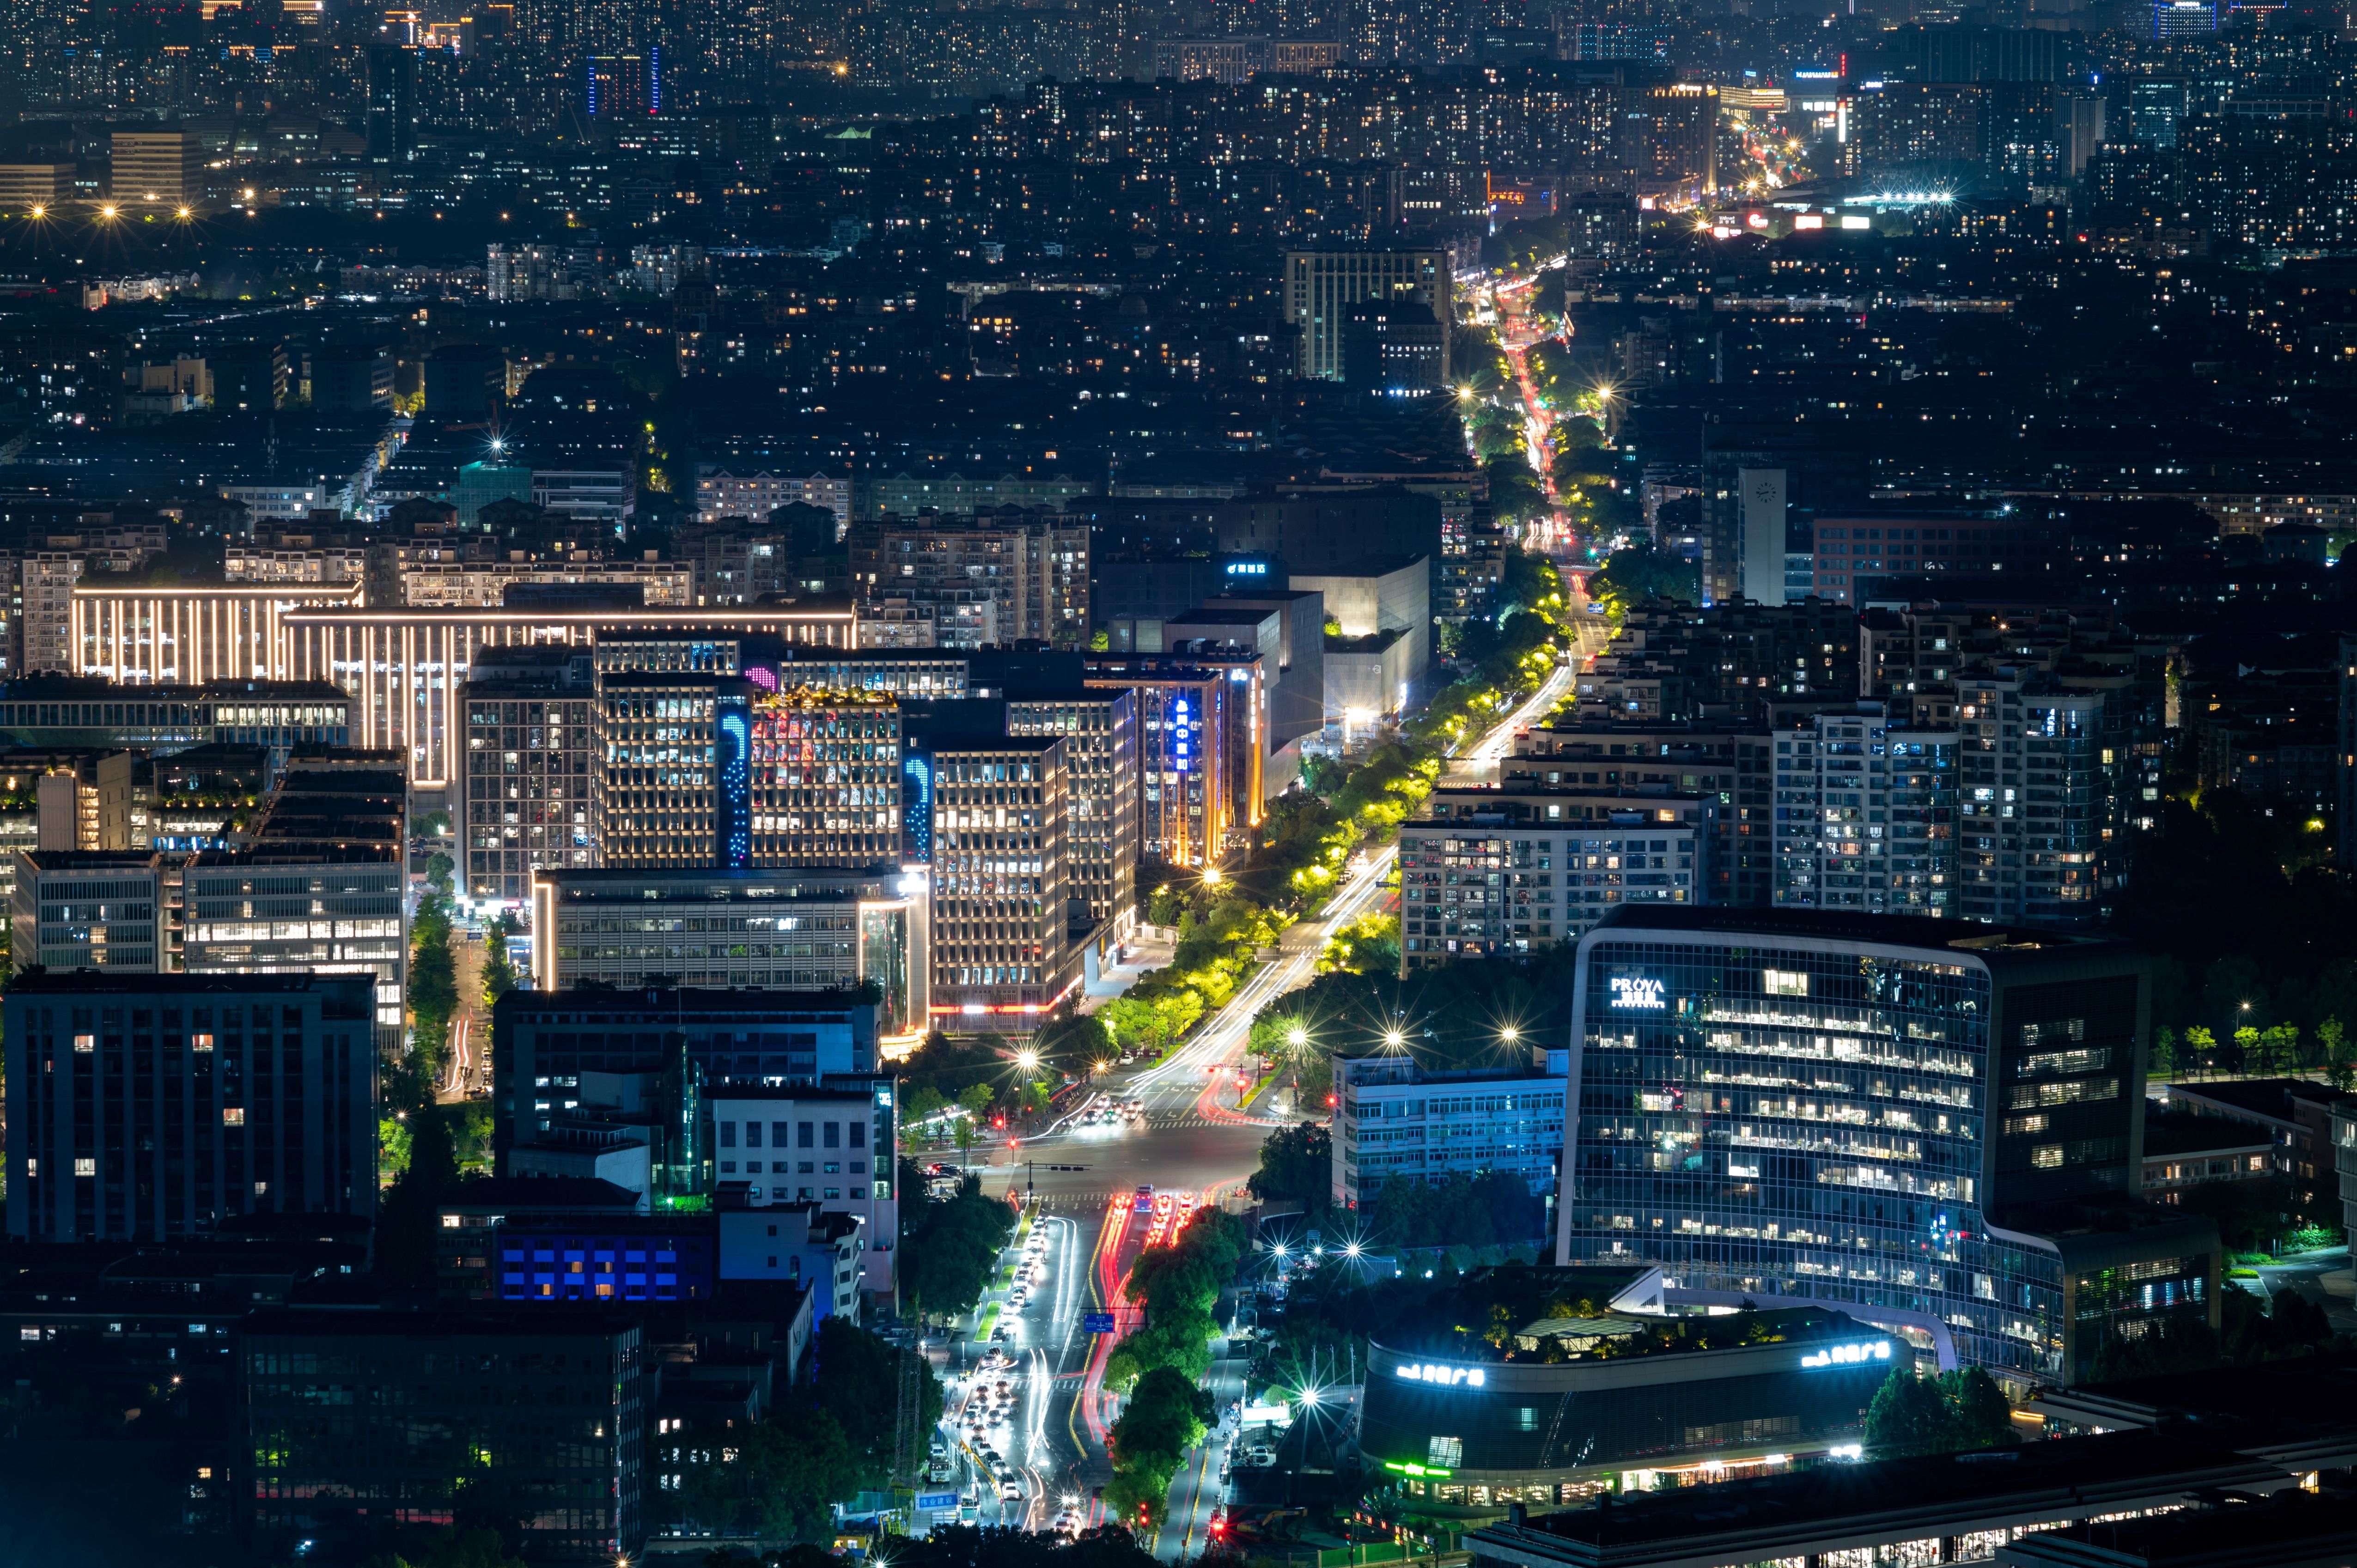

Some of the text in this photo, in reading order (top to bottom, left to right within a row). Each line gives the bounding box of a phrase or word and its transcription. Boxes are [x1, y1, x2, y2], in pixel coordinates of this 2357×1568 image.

[1611, 978, 1664, 992] PROYA
[920, 1496, 952, 1506] 伟业建设
